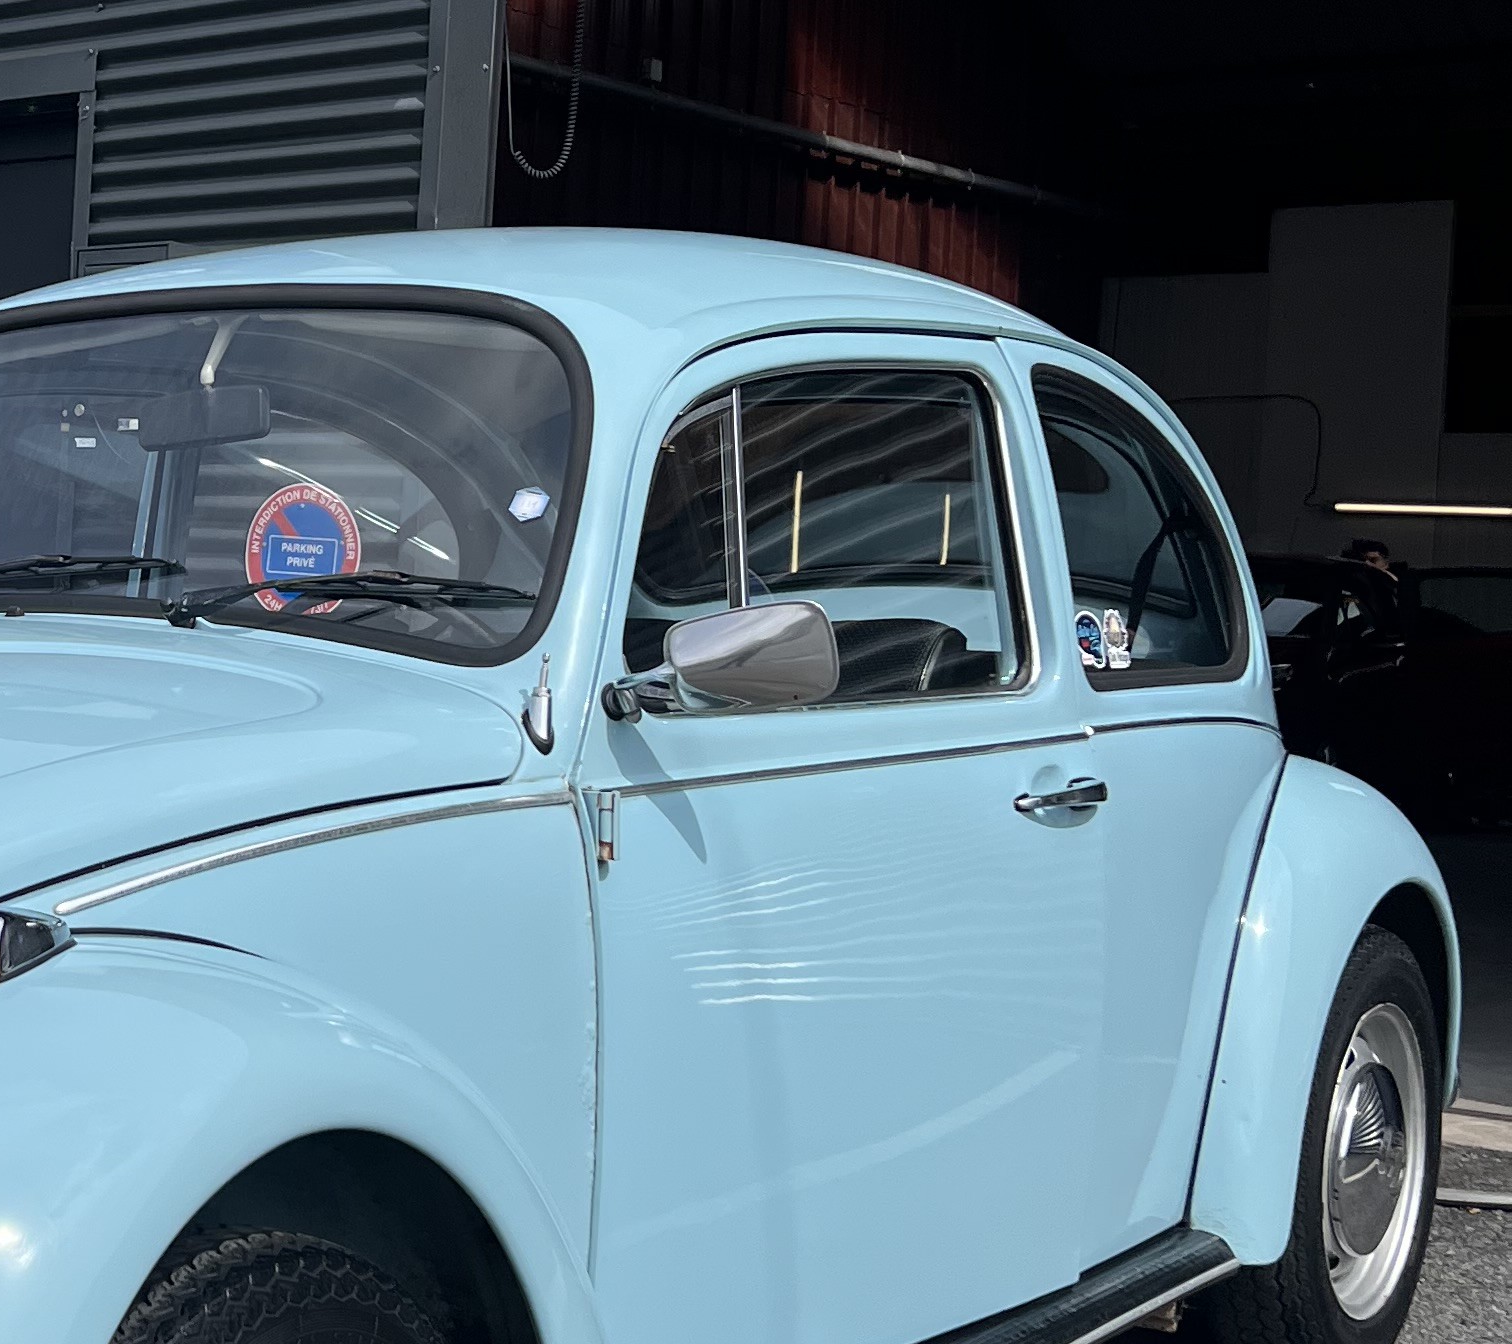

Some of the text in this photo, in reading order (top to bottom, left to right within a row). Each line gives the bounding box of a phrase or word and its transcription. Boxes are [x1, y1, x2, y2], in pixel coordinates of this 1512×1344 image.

[251, 489, 356, 561] INTERDICTION DE STATIONNER
[281, 543, 324, 555] PARKING
[286, 556, 316, 568] PRIVÉ
